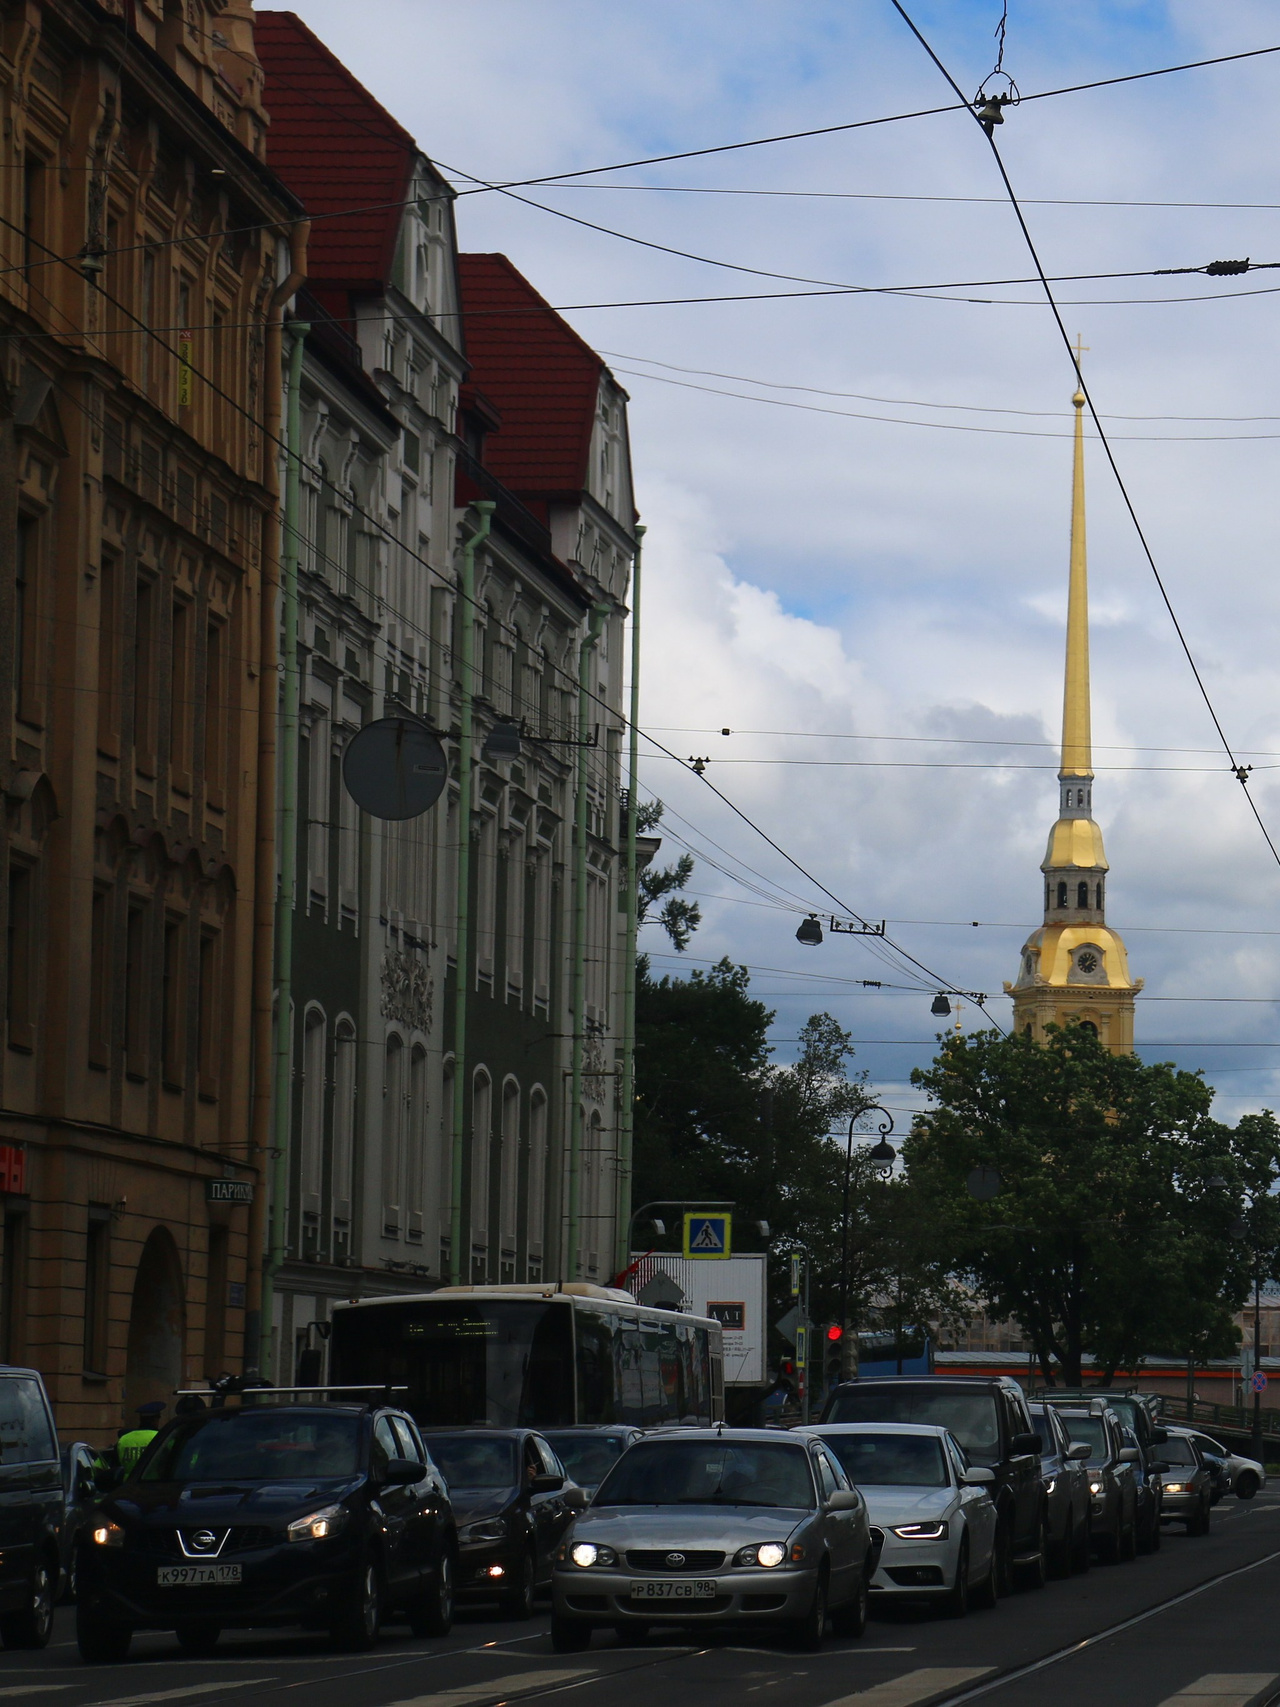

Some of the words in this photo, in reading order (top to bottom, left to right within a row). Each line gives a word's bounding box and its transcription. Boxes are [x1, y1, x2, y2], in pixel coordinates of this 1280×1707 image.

[162, 1568, 216, 1582] К997ТА
[218, 1565, 238, 1577] 178
[636, 1583, 692, 1597] Р837СВ
[696, 1582, 711, 1592] 98
